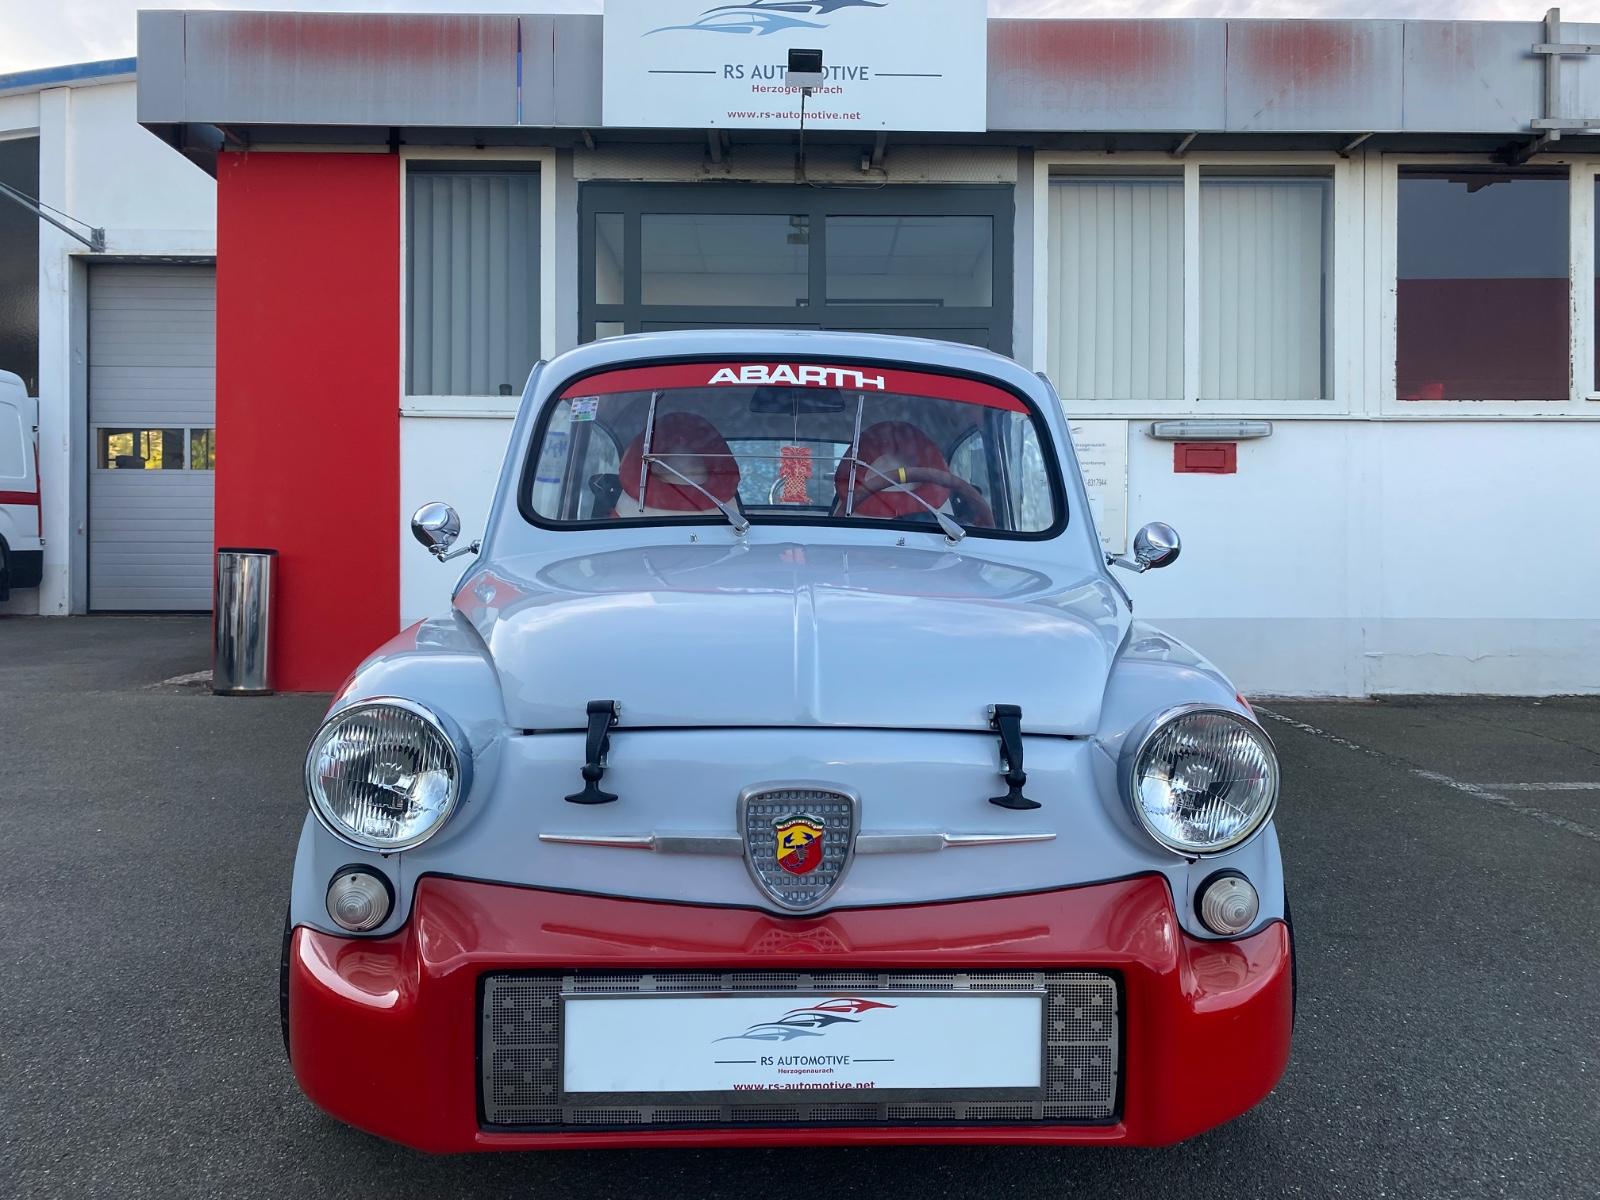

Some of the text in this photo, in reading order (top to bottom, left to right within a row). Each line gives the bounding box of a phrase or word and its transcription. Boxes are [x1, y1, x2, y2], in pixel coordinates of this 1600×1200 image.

[724, 64, 869, 80] RS AUTOTIVE
[752, 85, 843, 95] Herzogeurach
[727, 110, 861, 120] www.rs-automotive.net
[707, 364, 885, 390] ABARTH
[760, 1055, 850, 1066] RS AUTOMOTIVE
